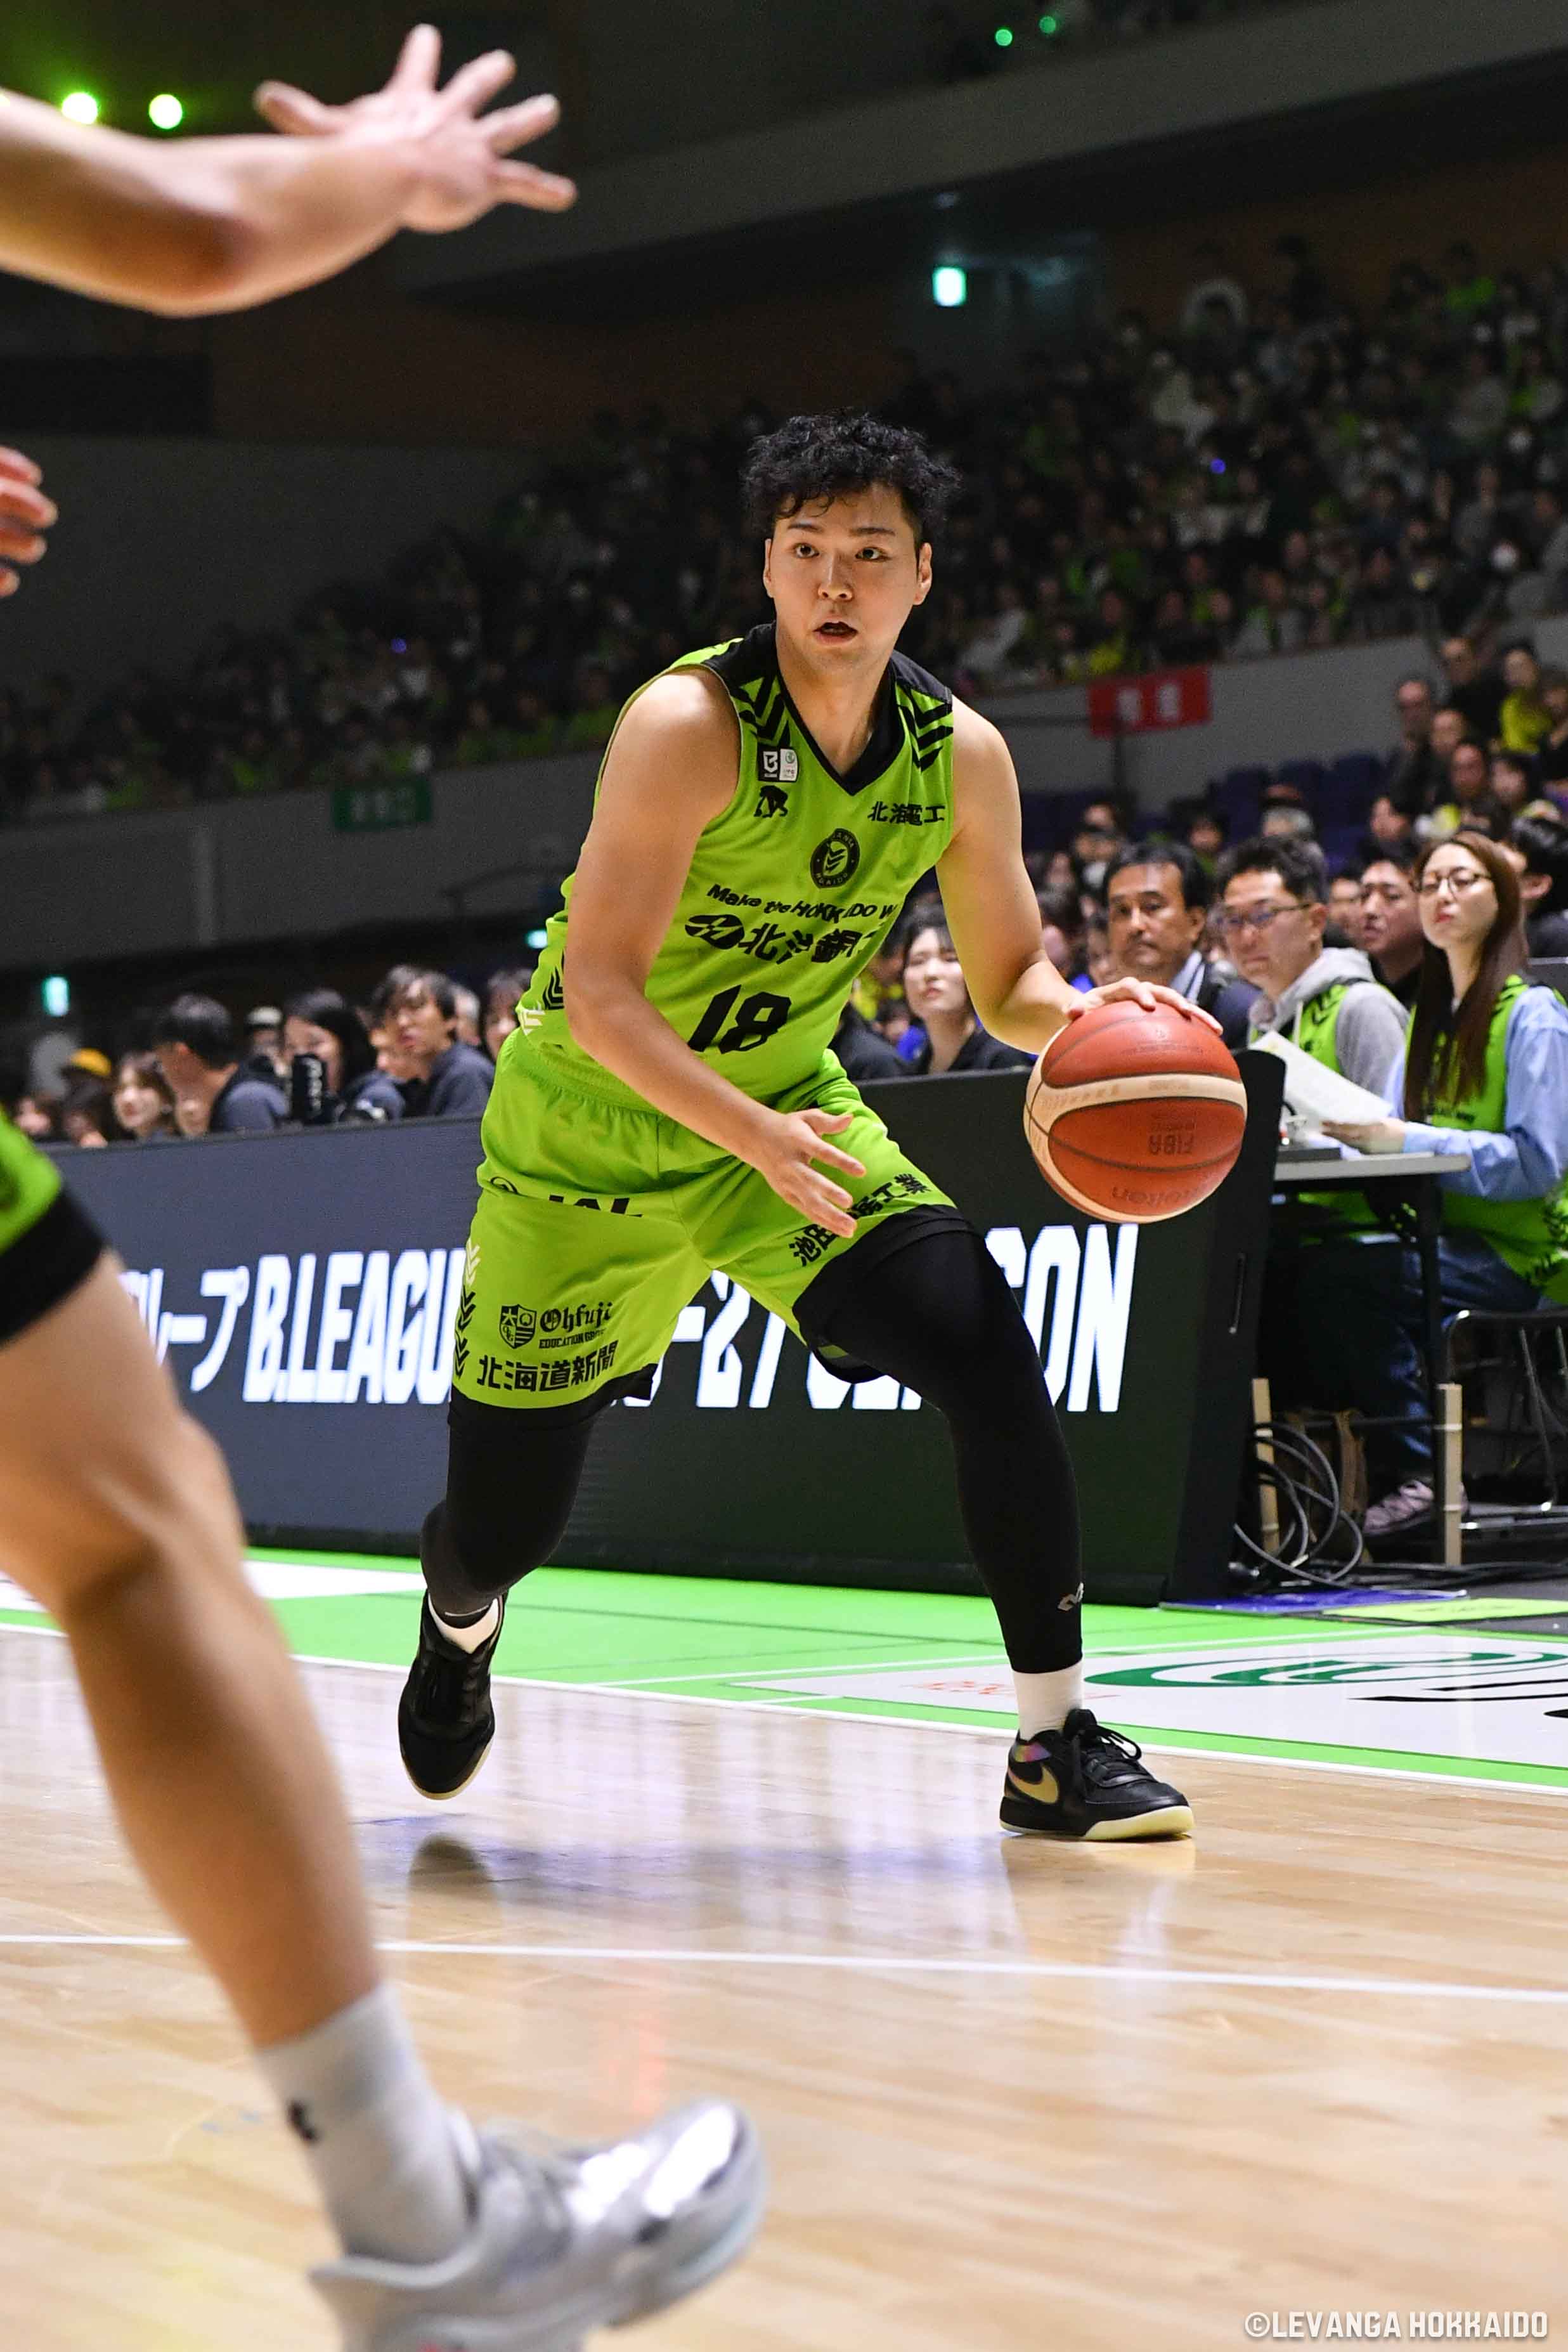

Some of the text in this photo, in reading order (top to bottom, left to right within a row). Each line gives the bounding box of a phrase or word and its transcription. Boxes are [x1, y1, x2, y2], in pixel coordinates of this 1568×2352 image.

[706, 883, 762, 907] Make
[687, 984, 792, 1055] 18
[242, 1247, 467, 1405] B.LEAGU
[540, 1301, 612, 1332] Ohfuji
[477, 1339, 619, 1391] 北海道新聞
